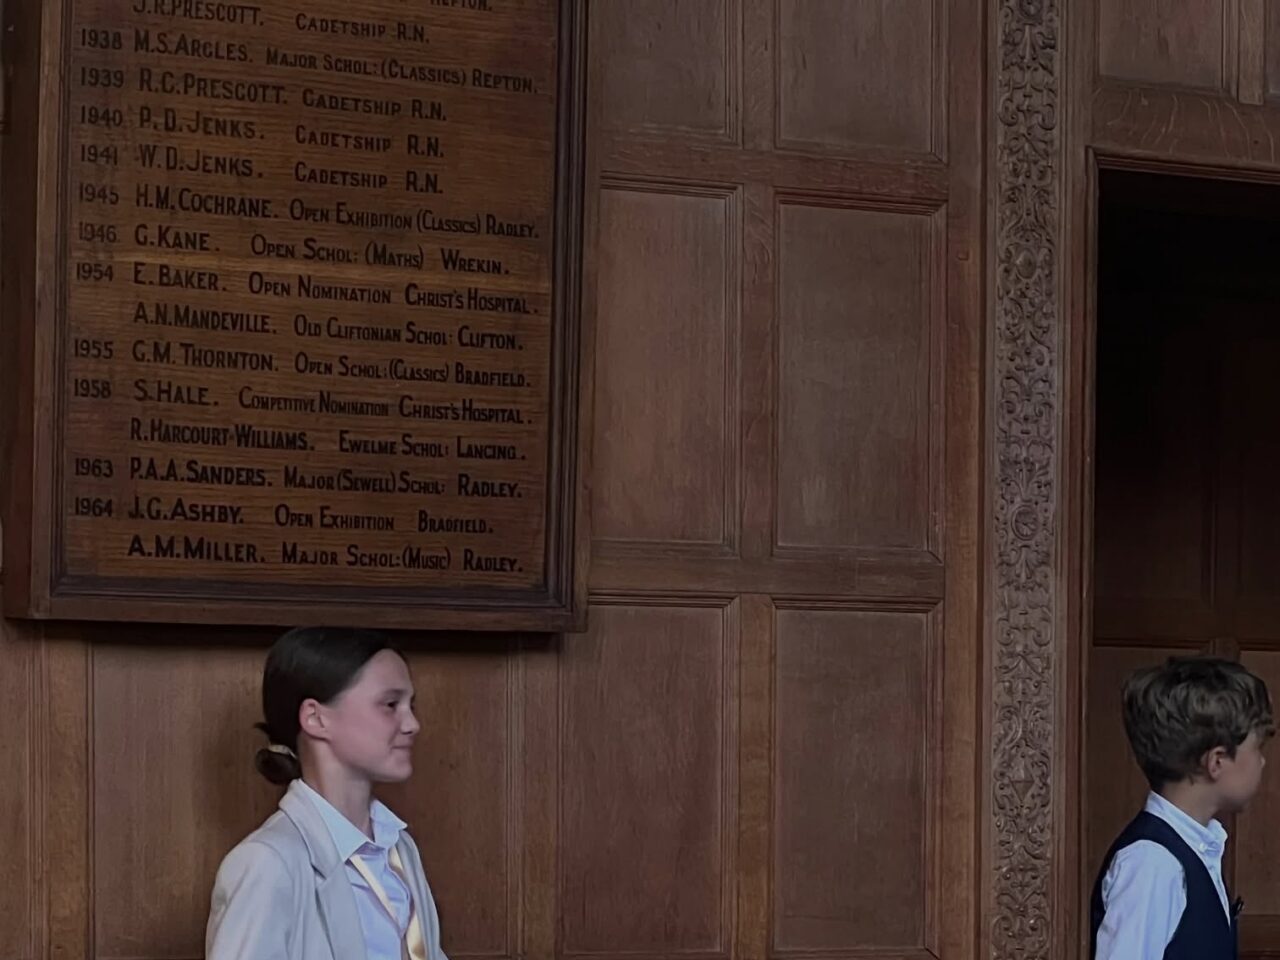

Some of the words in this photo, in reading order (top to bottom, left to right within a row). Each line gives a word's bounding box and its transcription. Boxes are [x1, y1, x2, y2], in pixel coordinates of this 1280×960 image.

[81, 28, 122, 50] 1938
[80, 67, 124, 88] 1939
[81, 106, 123, 128] 1940
[81, 144, 118, 166] 1941
[79, 182, 119, 205] 1945
[79, 221, 117, 244] 1946
[76, 262, 114, 282] 1954
[74, 339, 114, 359] 1955
[74, 379, 112, 399] 1958
[75, 458, 113, 478] 1963
[75, 497, 113, 518] 1964
